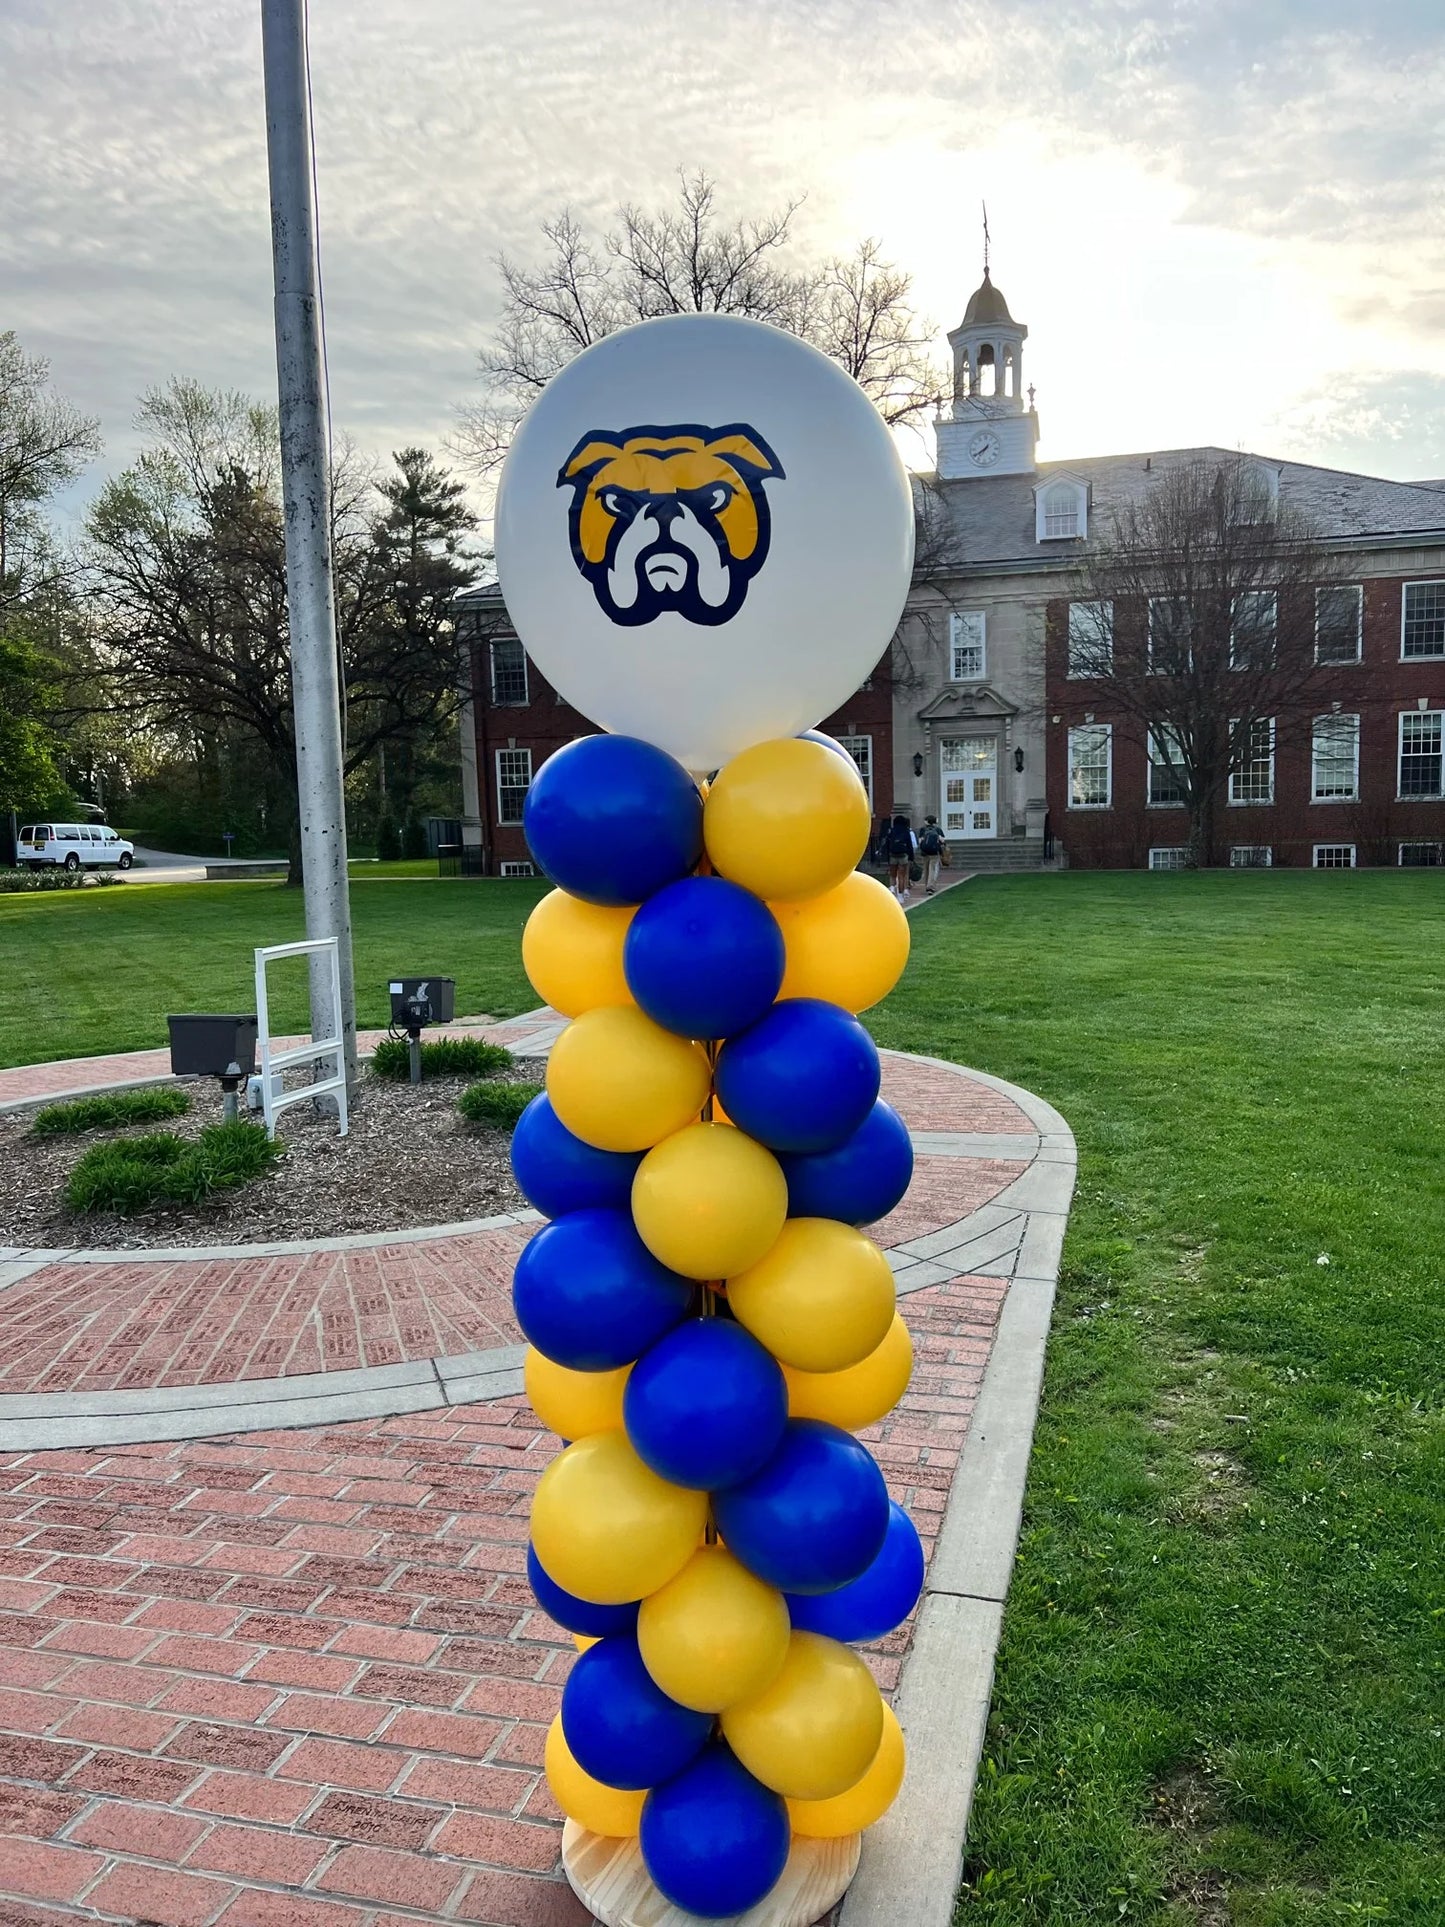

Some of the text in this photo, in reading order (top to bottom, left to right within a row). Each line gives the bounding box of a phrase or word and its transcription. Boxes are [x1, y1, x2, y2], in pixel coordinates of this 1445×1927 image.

[92, 1758, 119, 1768] KELLY
[322, 1800, 370, 1816] LAUREN
[352, 1821, 382, 1832] 2010
